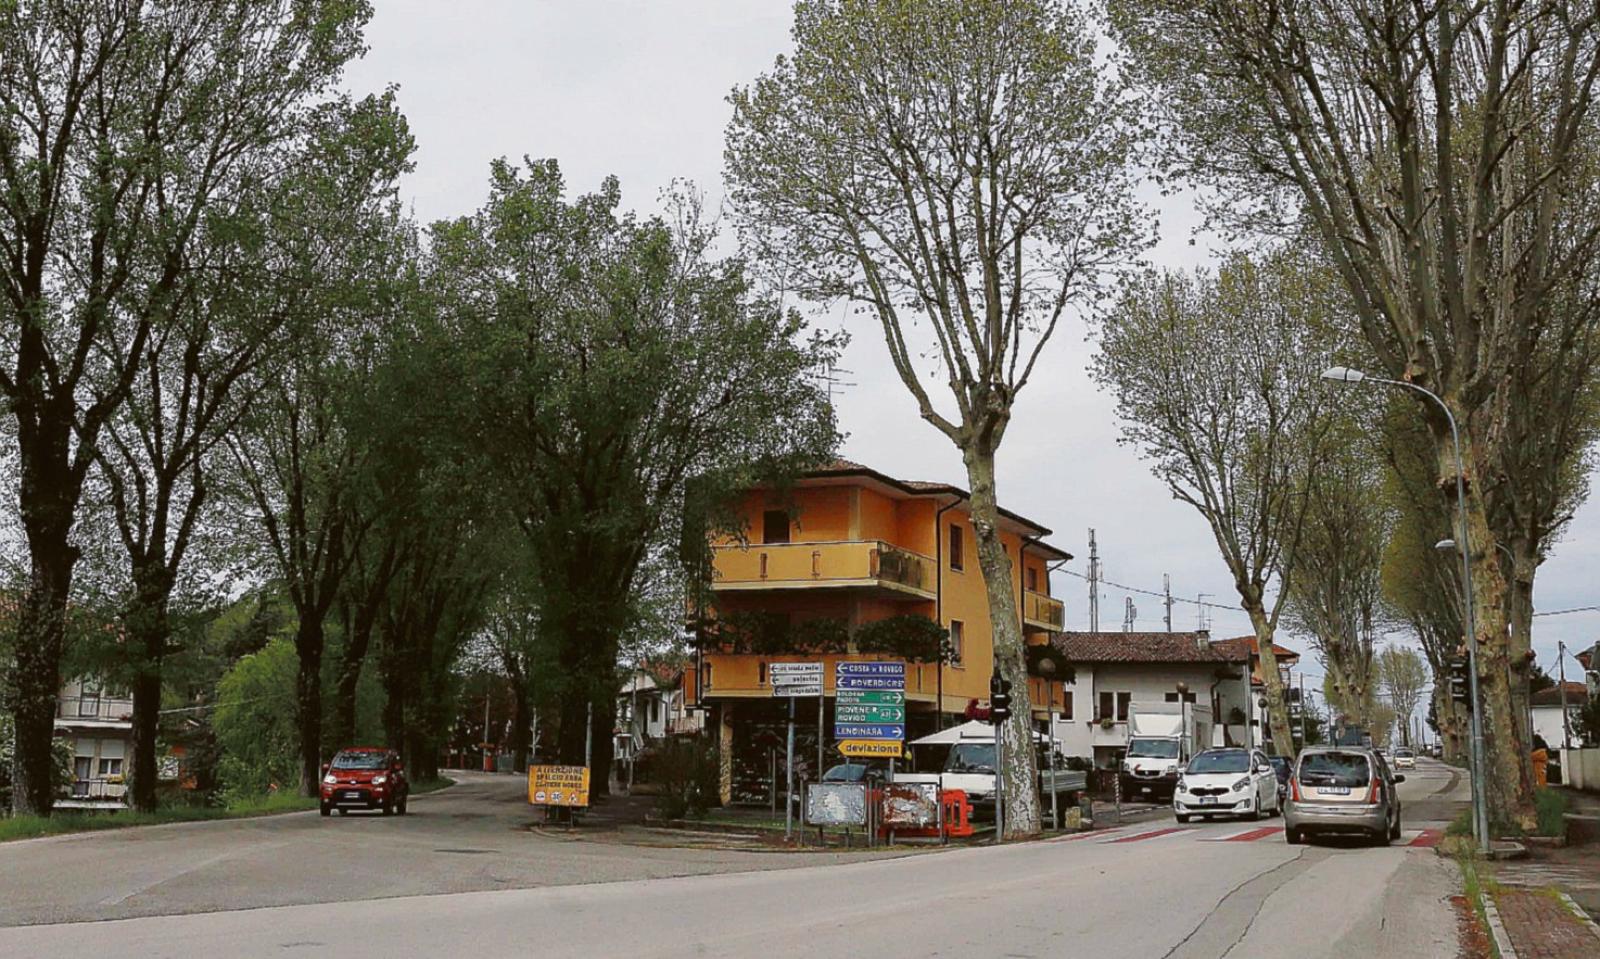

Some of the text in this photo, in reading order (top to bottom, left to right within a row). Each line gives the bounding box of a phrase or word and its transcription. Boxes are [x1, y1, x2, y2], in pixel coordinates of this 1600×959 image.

[849, 665, 869, 673] COSTA
[879, 665, 903, 673] ROVIGO
[837, 714, 866, 722] ROVIGO
[846, 743, 899, 753] deviazione
